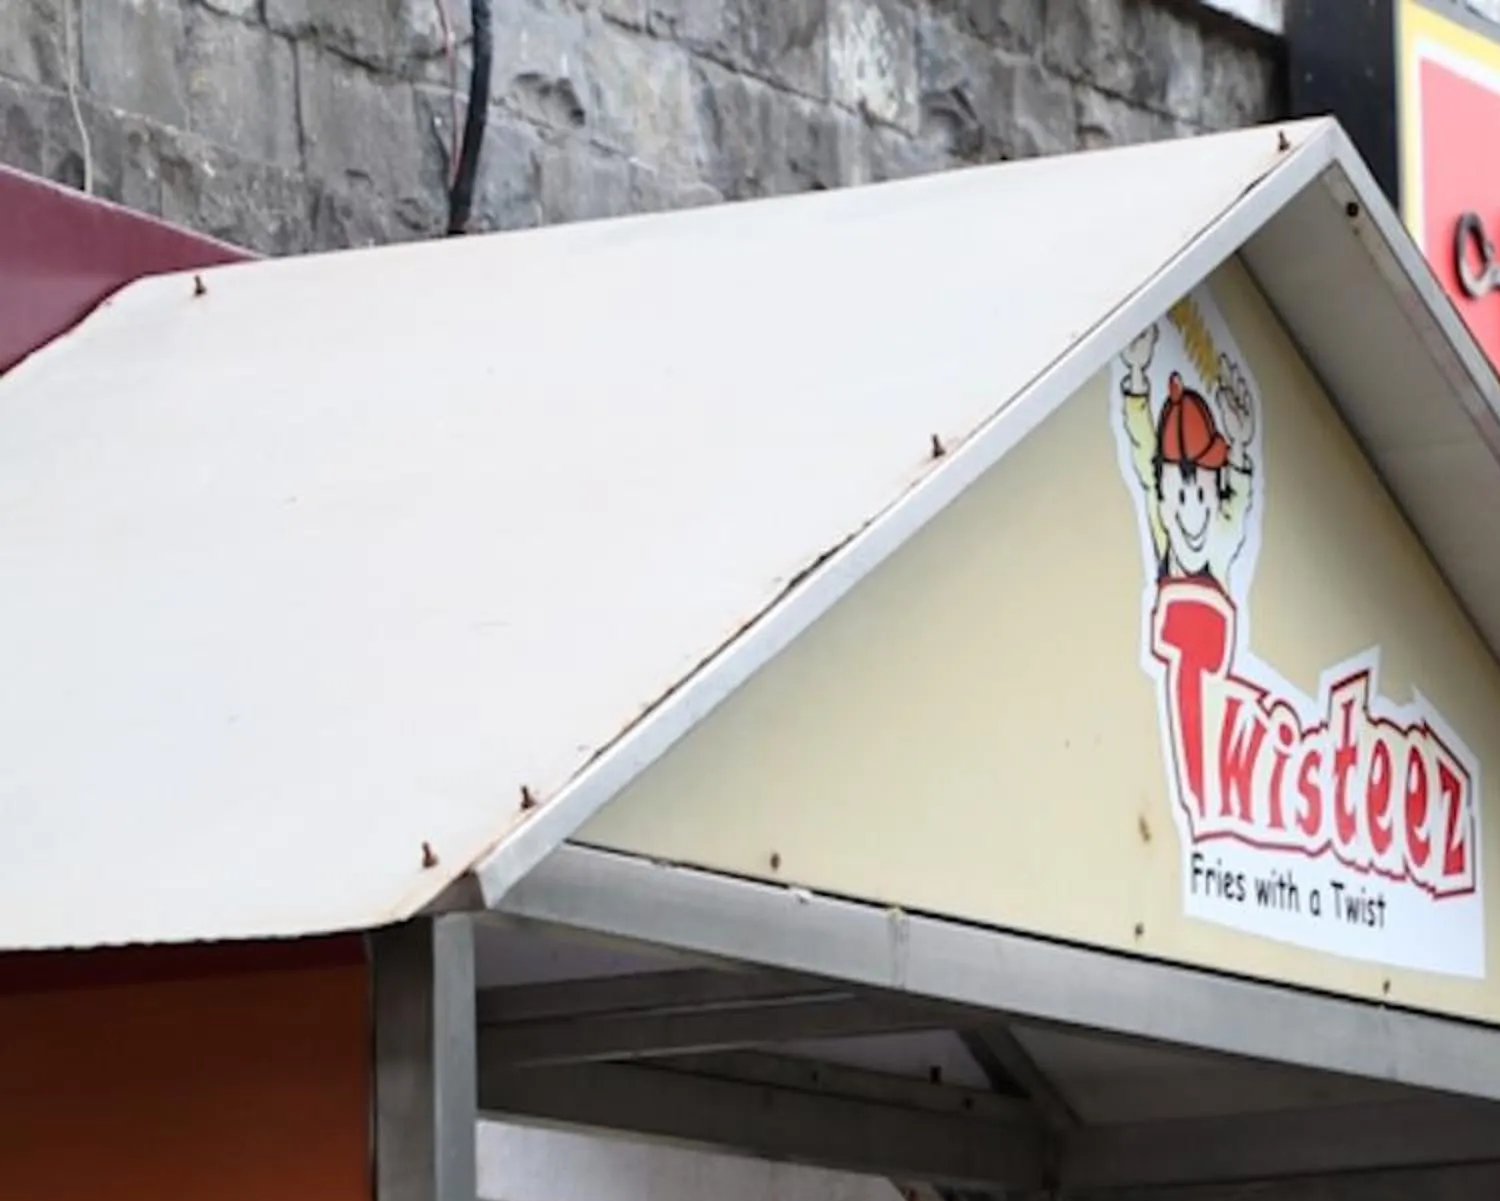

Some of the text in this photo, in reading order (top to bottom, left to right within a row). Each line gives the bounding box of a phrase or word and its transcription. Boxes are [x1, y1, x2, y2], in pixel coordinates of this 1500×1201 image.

[1160, 599, 1466, 877] Twisteez
[1190, 852, 1385, 929] Fries with a Twist
